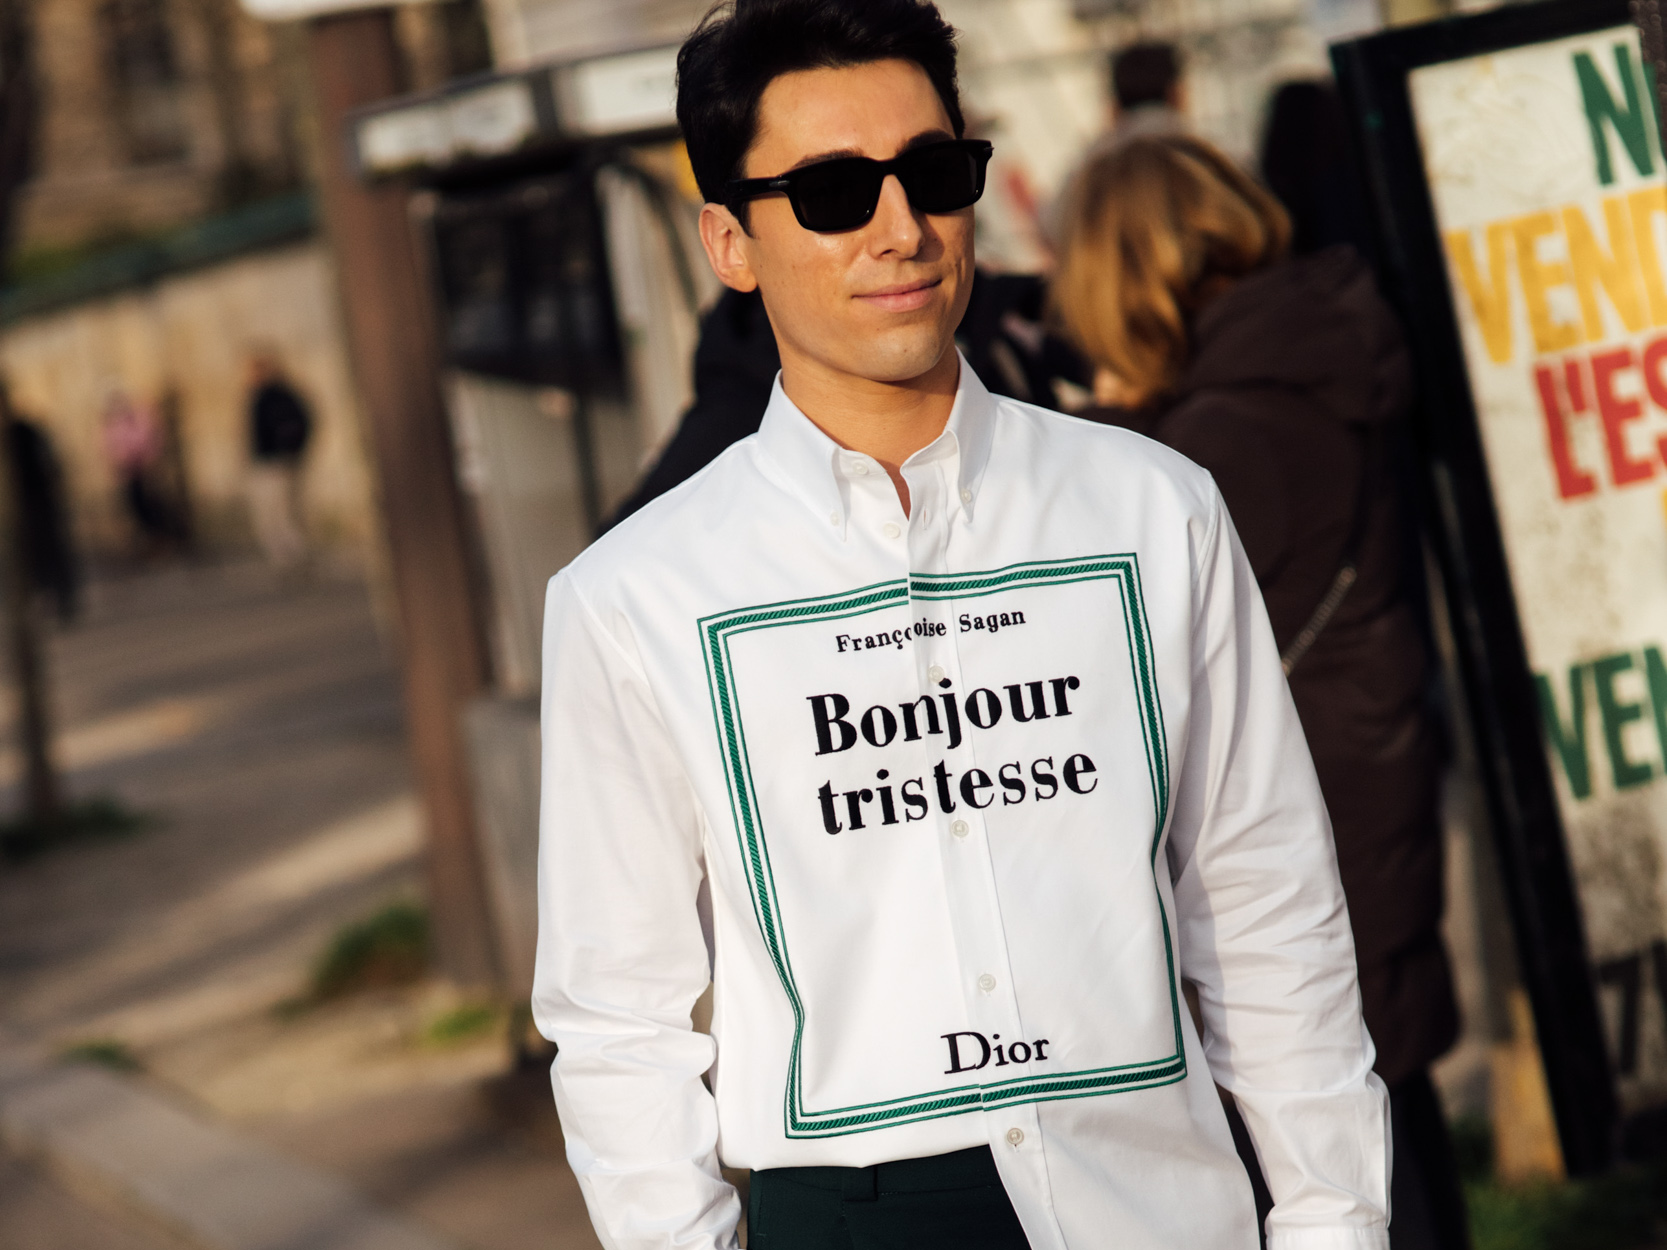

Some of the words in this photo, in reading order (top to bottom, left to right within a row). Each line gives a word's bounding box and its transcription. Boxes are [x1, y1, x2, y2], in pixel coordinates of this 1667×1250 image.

[836, 617, 947, 653] Françoise
[959, 611, 1026, 634] Sagan
[806, 675, 1080, 757] Bonjour
[817, 753, 1098, 836] tristesse
[940, 1031, 1050, 1075] Dior
